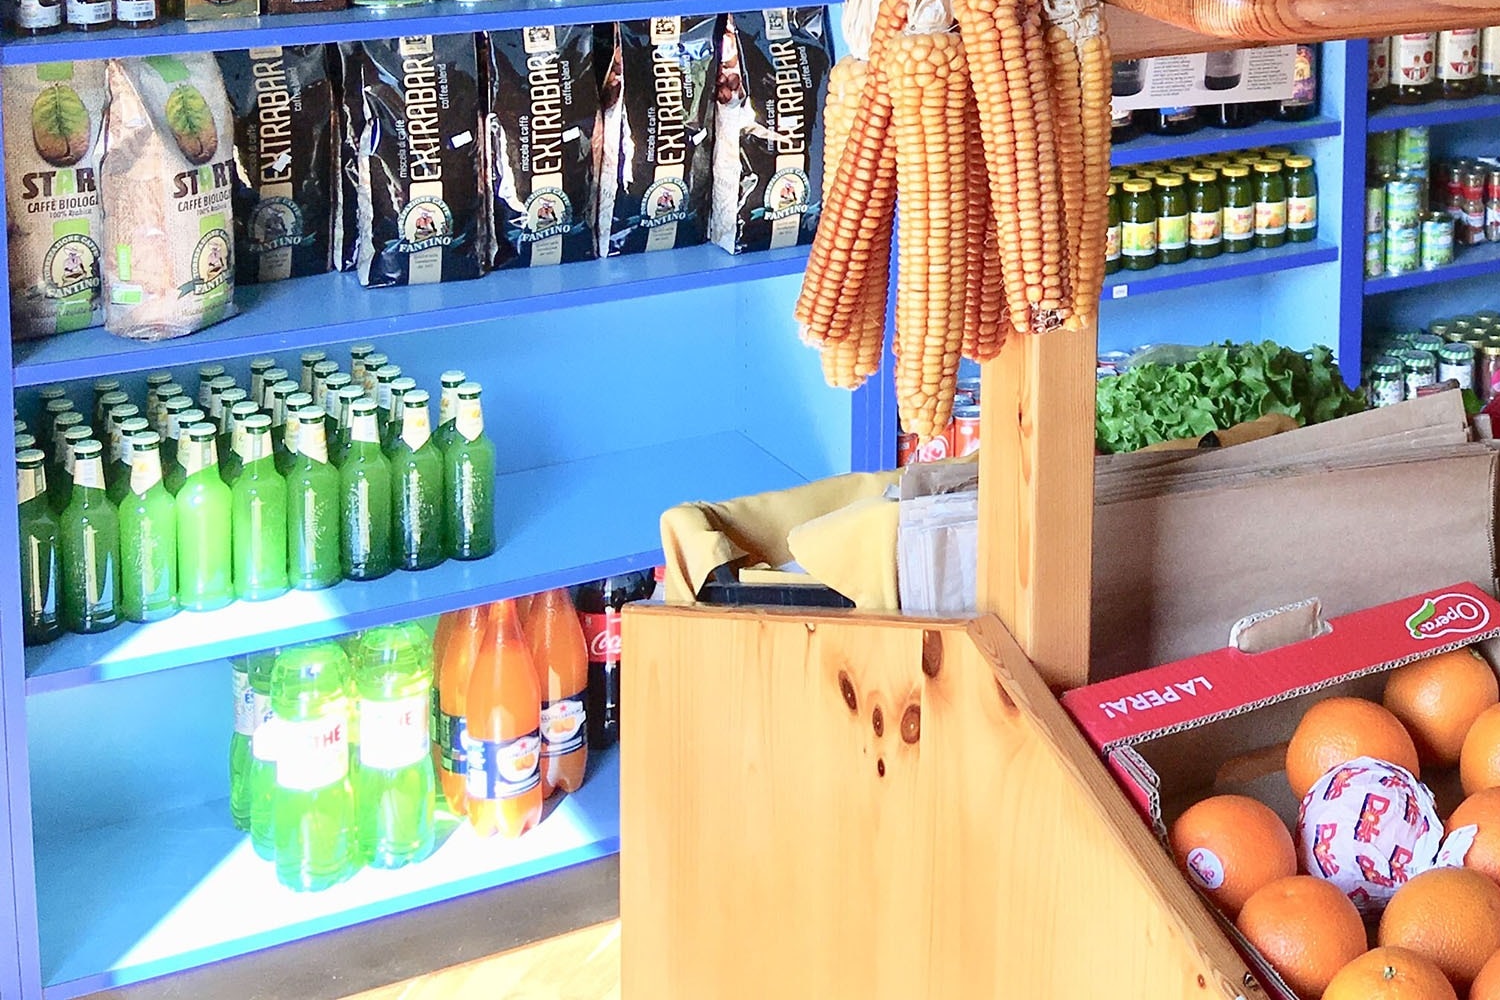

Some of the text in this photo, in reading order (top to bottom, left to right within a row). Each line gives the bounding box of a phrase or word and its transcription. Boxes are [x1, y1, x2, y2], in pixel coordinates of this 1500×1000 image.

[437, 63, 450, 109] coffee blend
[654, 47, 686, 165] EXTRABAR
[254, 60, 293, 185] EXTRABAR
[403, 56, 443, 181] EXTRABAR
[528, 54, 563, 174] EXTRABAR
[22, 168, 97, 200] STAR
[173, 159, 235, 199] START
[27, 195, 99, 214] CAFFÈ BIOLOG
[178, 190, 231, 212] CAFFÈ BIOLOG
[640, 210, 686, 228] FANTINO
[763, 204, 808, 221] FANTINO
[399, 235, 452, 254] FANTINO
[521, 222, 571, 243] FANTINO
[1418, 601, 1480, 635] Opera
[1099, 676, 1214, 721] LA PERA!
[1354, 792, 1391, 843] Dole
[1313, 823, 1340, 879] Dole
